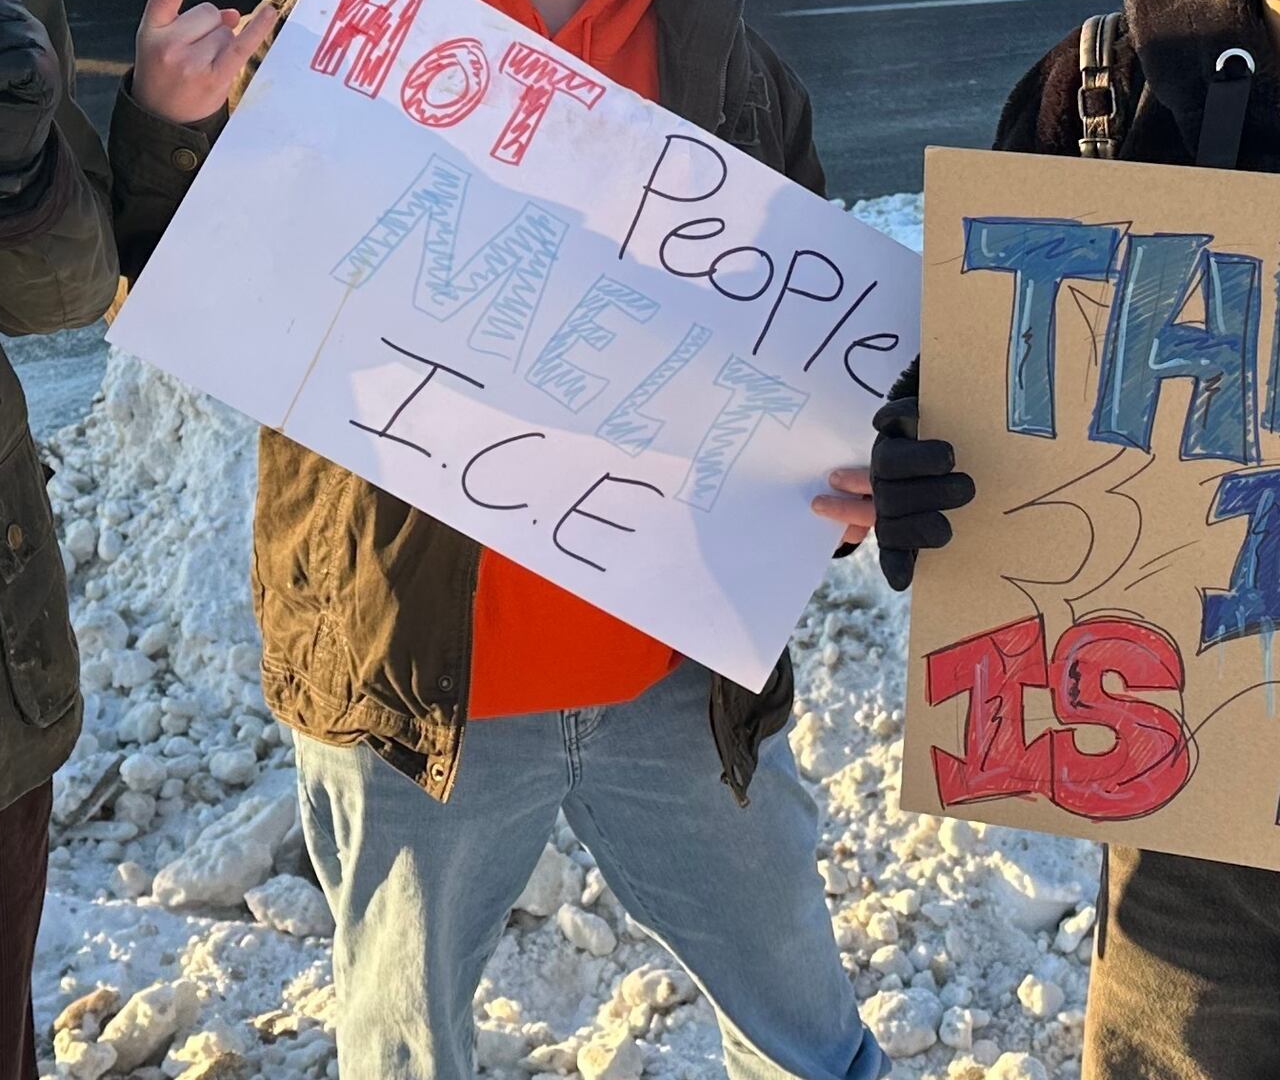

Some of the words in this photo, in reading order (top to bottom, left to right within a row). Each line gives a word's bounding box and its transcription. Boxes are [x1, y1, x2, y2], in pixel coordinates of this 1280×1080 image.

[331, 153, 810, 513] MELT
[349, 337, 665, 572] I.C.E
[921, 613, 1200, 823] IS
